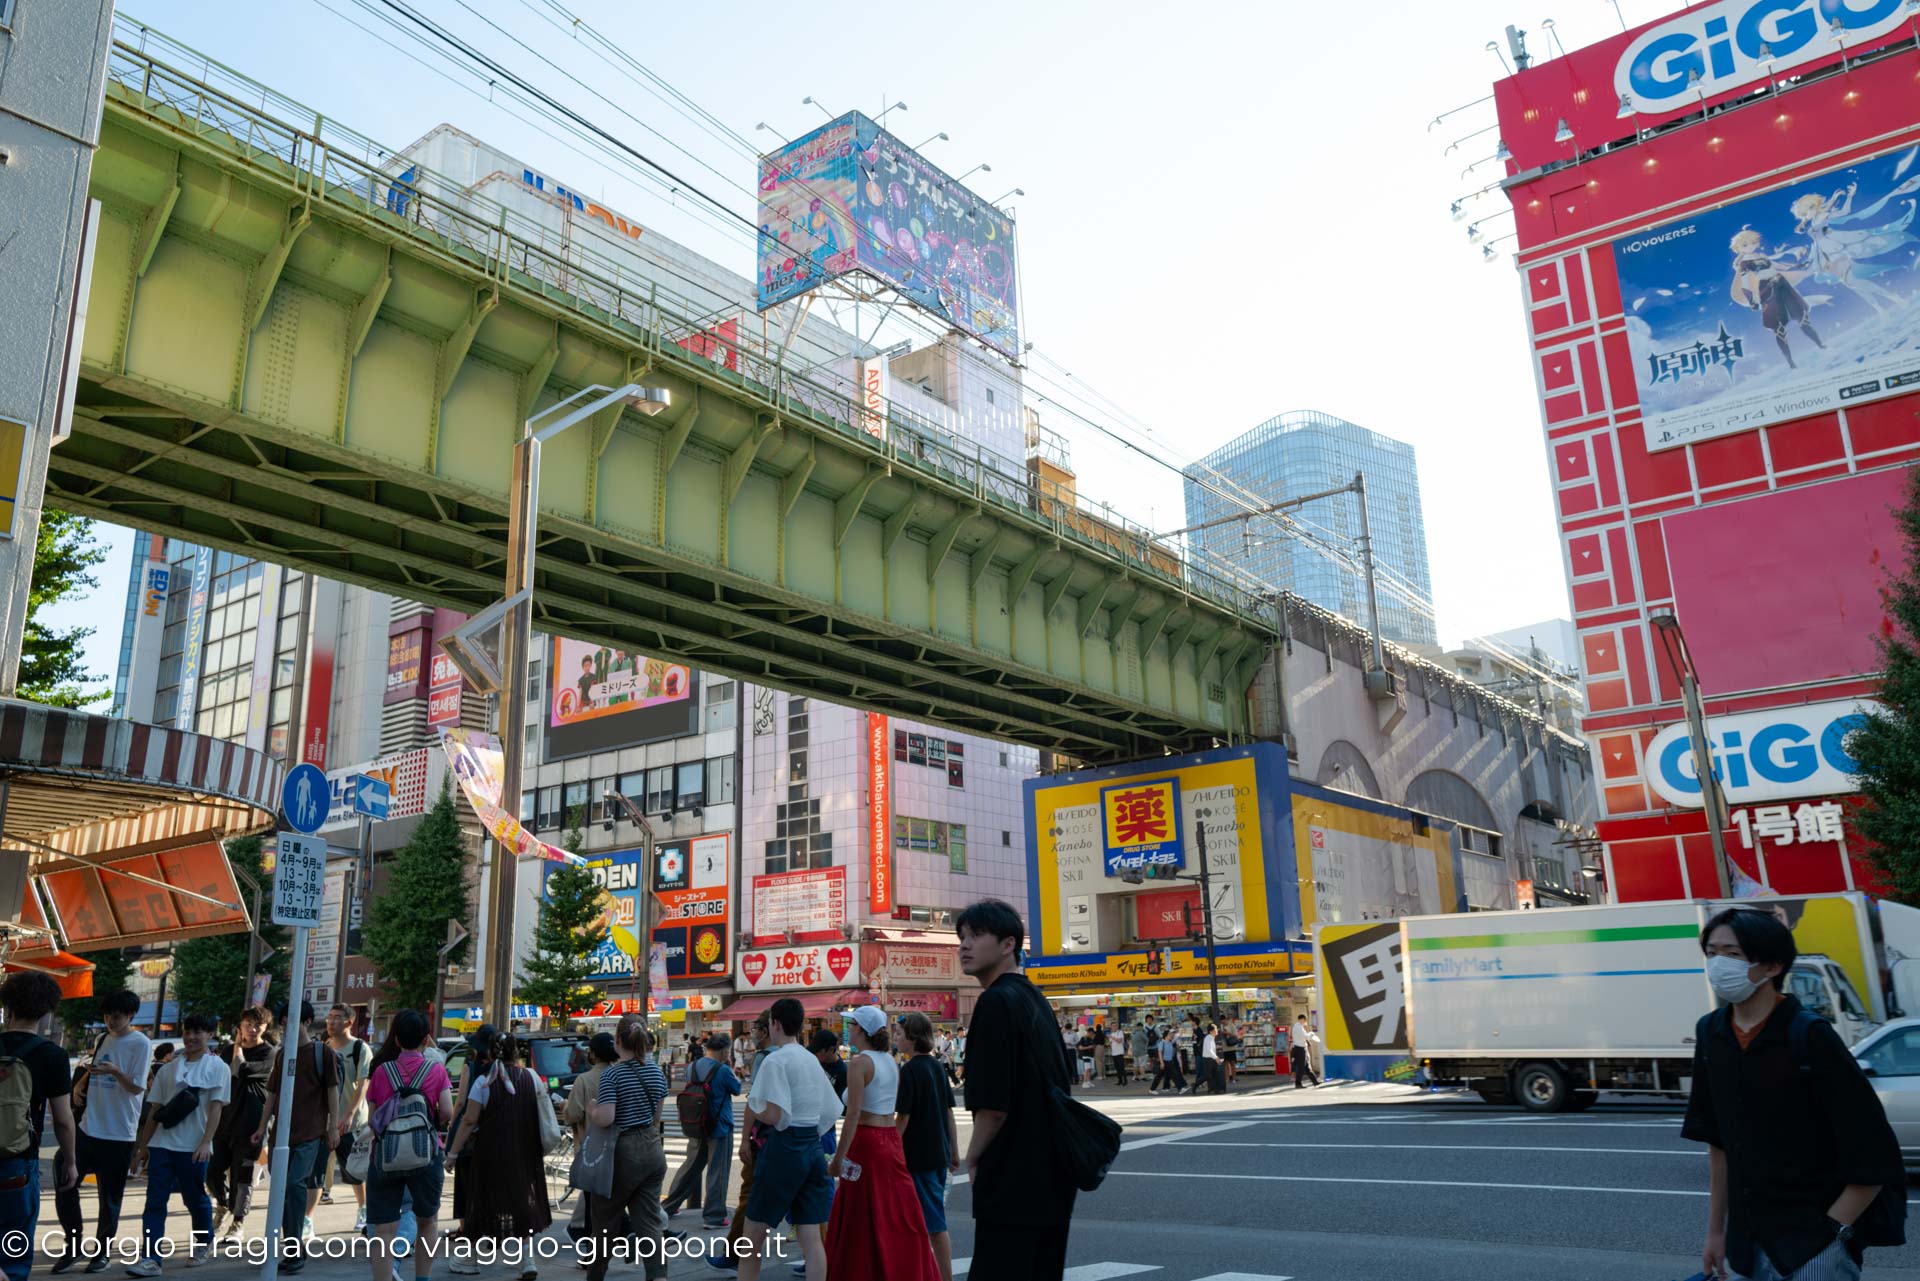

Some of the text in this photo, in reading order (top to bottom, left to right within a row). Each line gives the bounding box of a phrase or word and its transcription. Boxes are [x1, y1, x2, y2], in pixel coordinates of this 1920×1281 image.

[1623, 225, 1697, 254] HOYOVERSE
[1647, 321, 1744, 387] 原神
[1774, 395, 1832, 415] Windows
[601, 678, 637, 694] ミドリーズ
[1660, 713, 1870, 793] GiGO
[1190, 786, 1250, 803] SHISEIDO
[874, 727, 884, 904] www.akibalovemerci.com
[1047, 808, 1097, 822] SHISEIDO
[1114, 788, 1168, 843] 薬
[1731, 801, 1844, 849] 1号館
[1051, 840, 1092, 852] Kanebo
[1123, 843, 1161, 853] DRUG STORE
[1055, 855, 1092, 866] SOFINA
[674, 892, 707, 903] ジーストア
[775, 949, 819, 970] LOVE
[1194, 958, 1276, 972] Maumoto KiYoshi
[1412, 956, 1503, 976] FamilyMart
[771, 965, 822, 986] merci
[1037, 968, 1107, 981] Matsumoto KiYoshi
